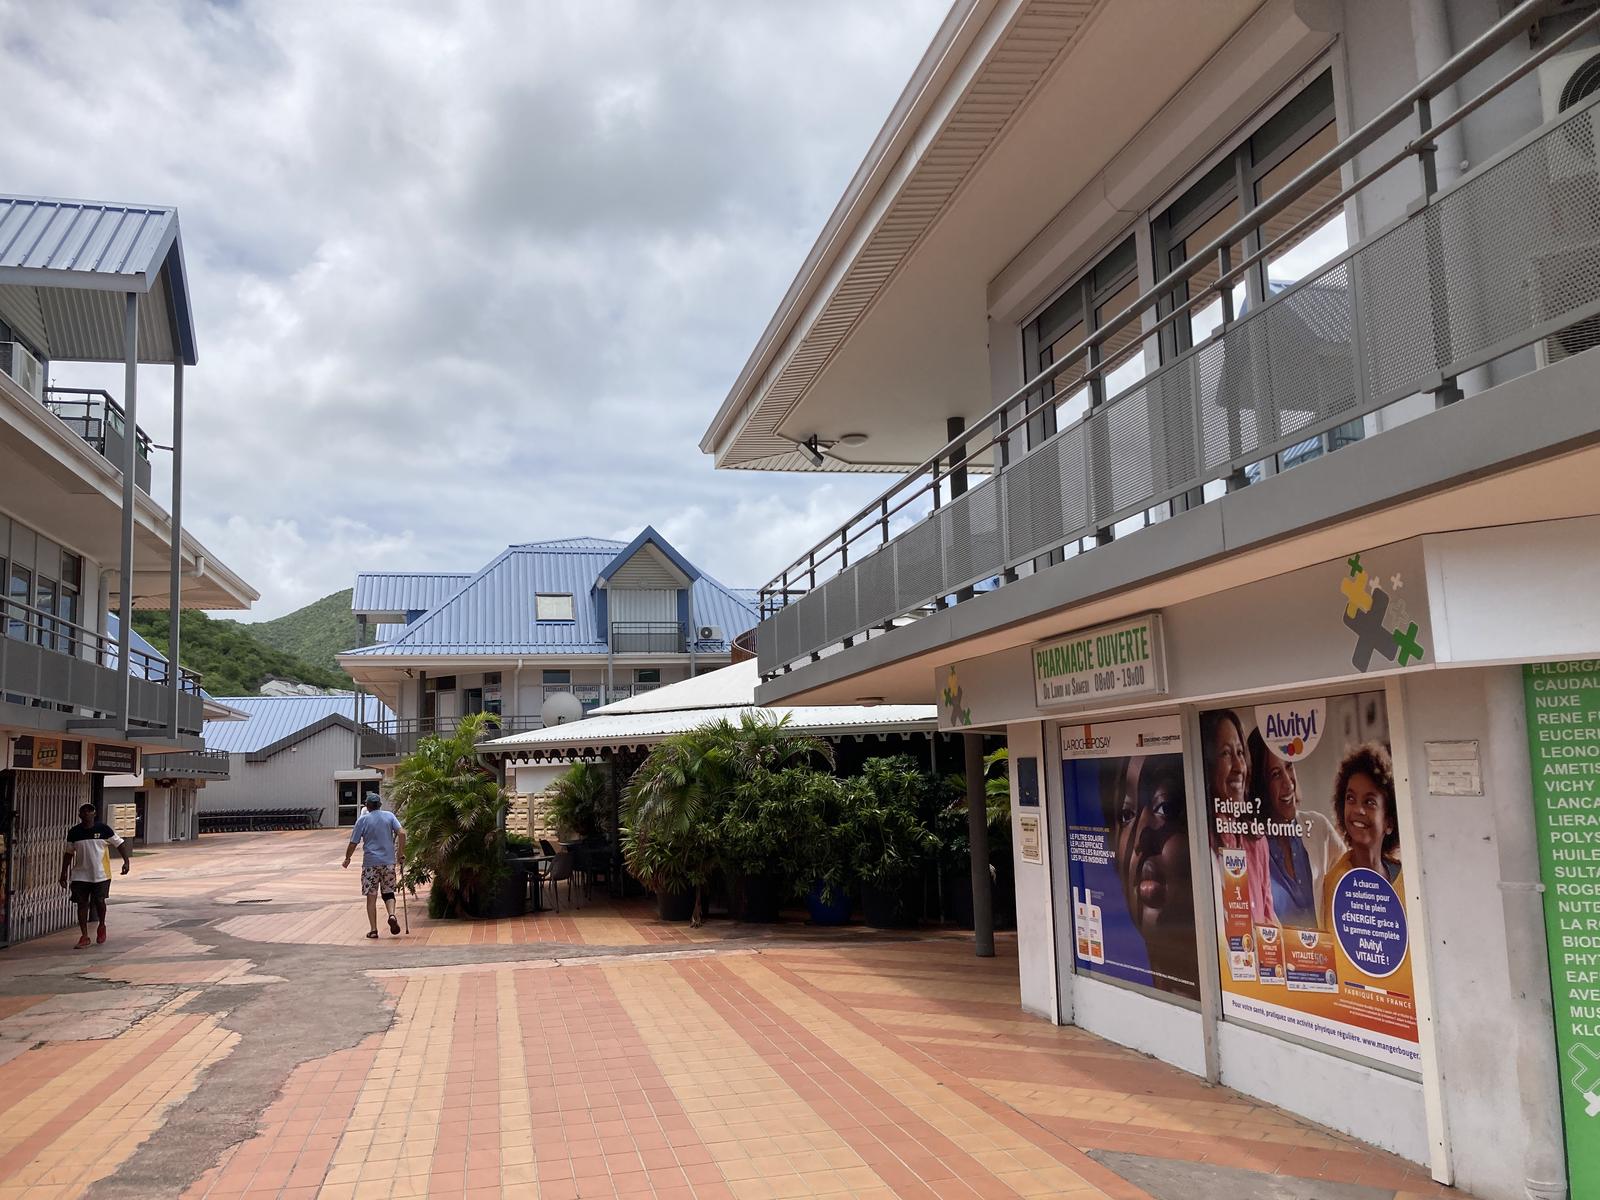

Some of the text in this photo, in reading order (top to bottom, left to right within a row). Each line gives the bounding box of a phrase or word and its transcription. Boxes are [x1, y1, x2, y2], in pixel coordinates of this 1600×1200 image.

[1036, 626, 1149, 680] PHARMACIE OUVERTE
[1533, 677, 1600, 691] CAUDAL
[1535, 695, 1581, 708] NUXE
[1537, 711, 1600, 725] RENE F
[1266, 709, 1317, 742] Alvityl
[1541, 745, 1599, 759] LEONO
[1544, 779, 1595, 792] VICHY
[1214, 797, 1262, 818] Fatigue ?
[1215, 817, 1312, 837] Baisse de forme ?
[1548, 814, 1600, 826] LIERA
[1552, 849, 1600, 861] HUILE
[1226, 856, 1246, 870] Alvityl
[1358, 879, 1379, 889] chacun
[1353, 890, 1375, 900] solution
[1376, 894, 1390, 902] pour
[1350, 901, 1387, 913] faire le plein
[1558, 901, 1600, 913] NUTE
[1377, 919, 1394, 928] grâce
[1560, 918, 1600, 930] LA R
[1343, 924, 1400, 941] la gamme complète
[1359, 938, 1383, 954] Alvityl
[1356, 950, 1386, 965] VITALITÉ
[1564, 953, 1600, 966] PHY
[1568, 988, 1600, 1001] AVE
[1376, 995, 1384, 1003] EN
[1386, 997, 1412, 1009] FRANCE
[1232, 999, 1241, 1009] Pour
[1242, 1004, 1252, 1012] votre
[1265, 1010, 1286, 1022] pratiquez
[1314, 1023, 1336, 1037] physique
